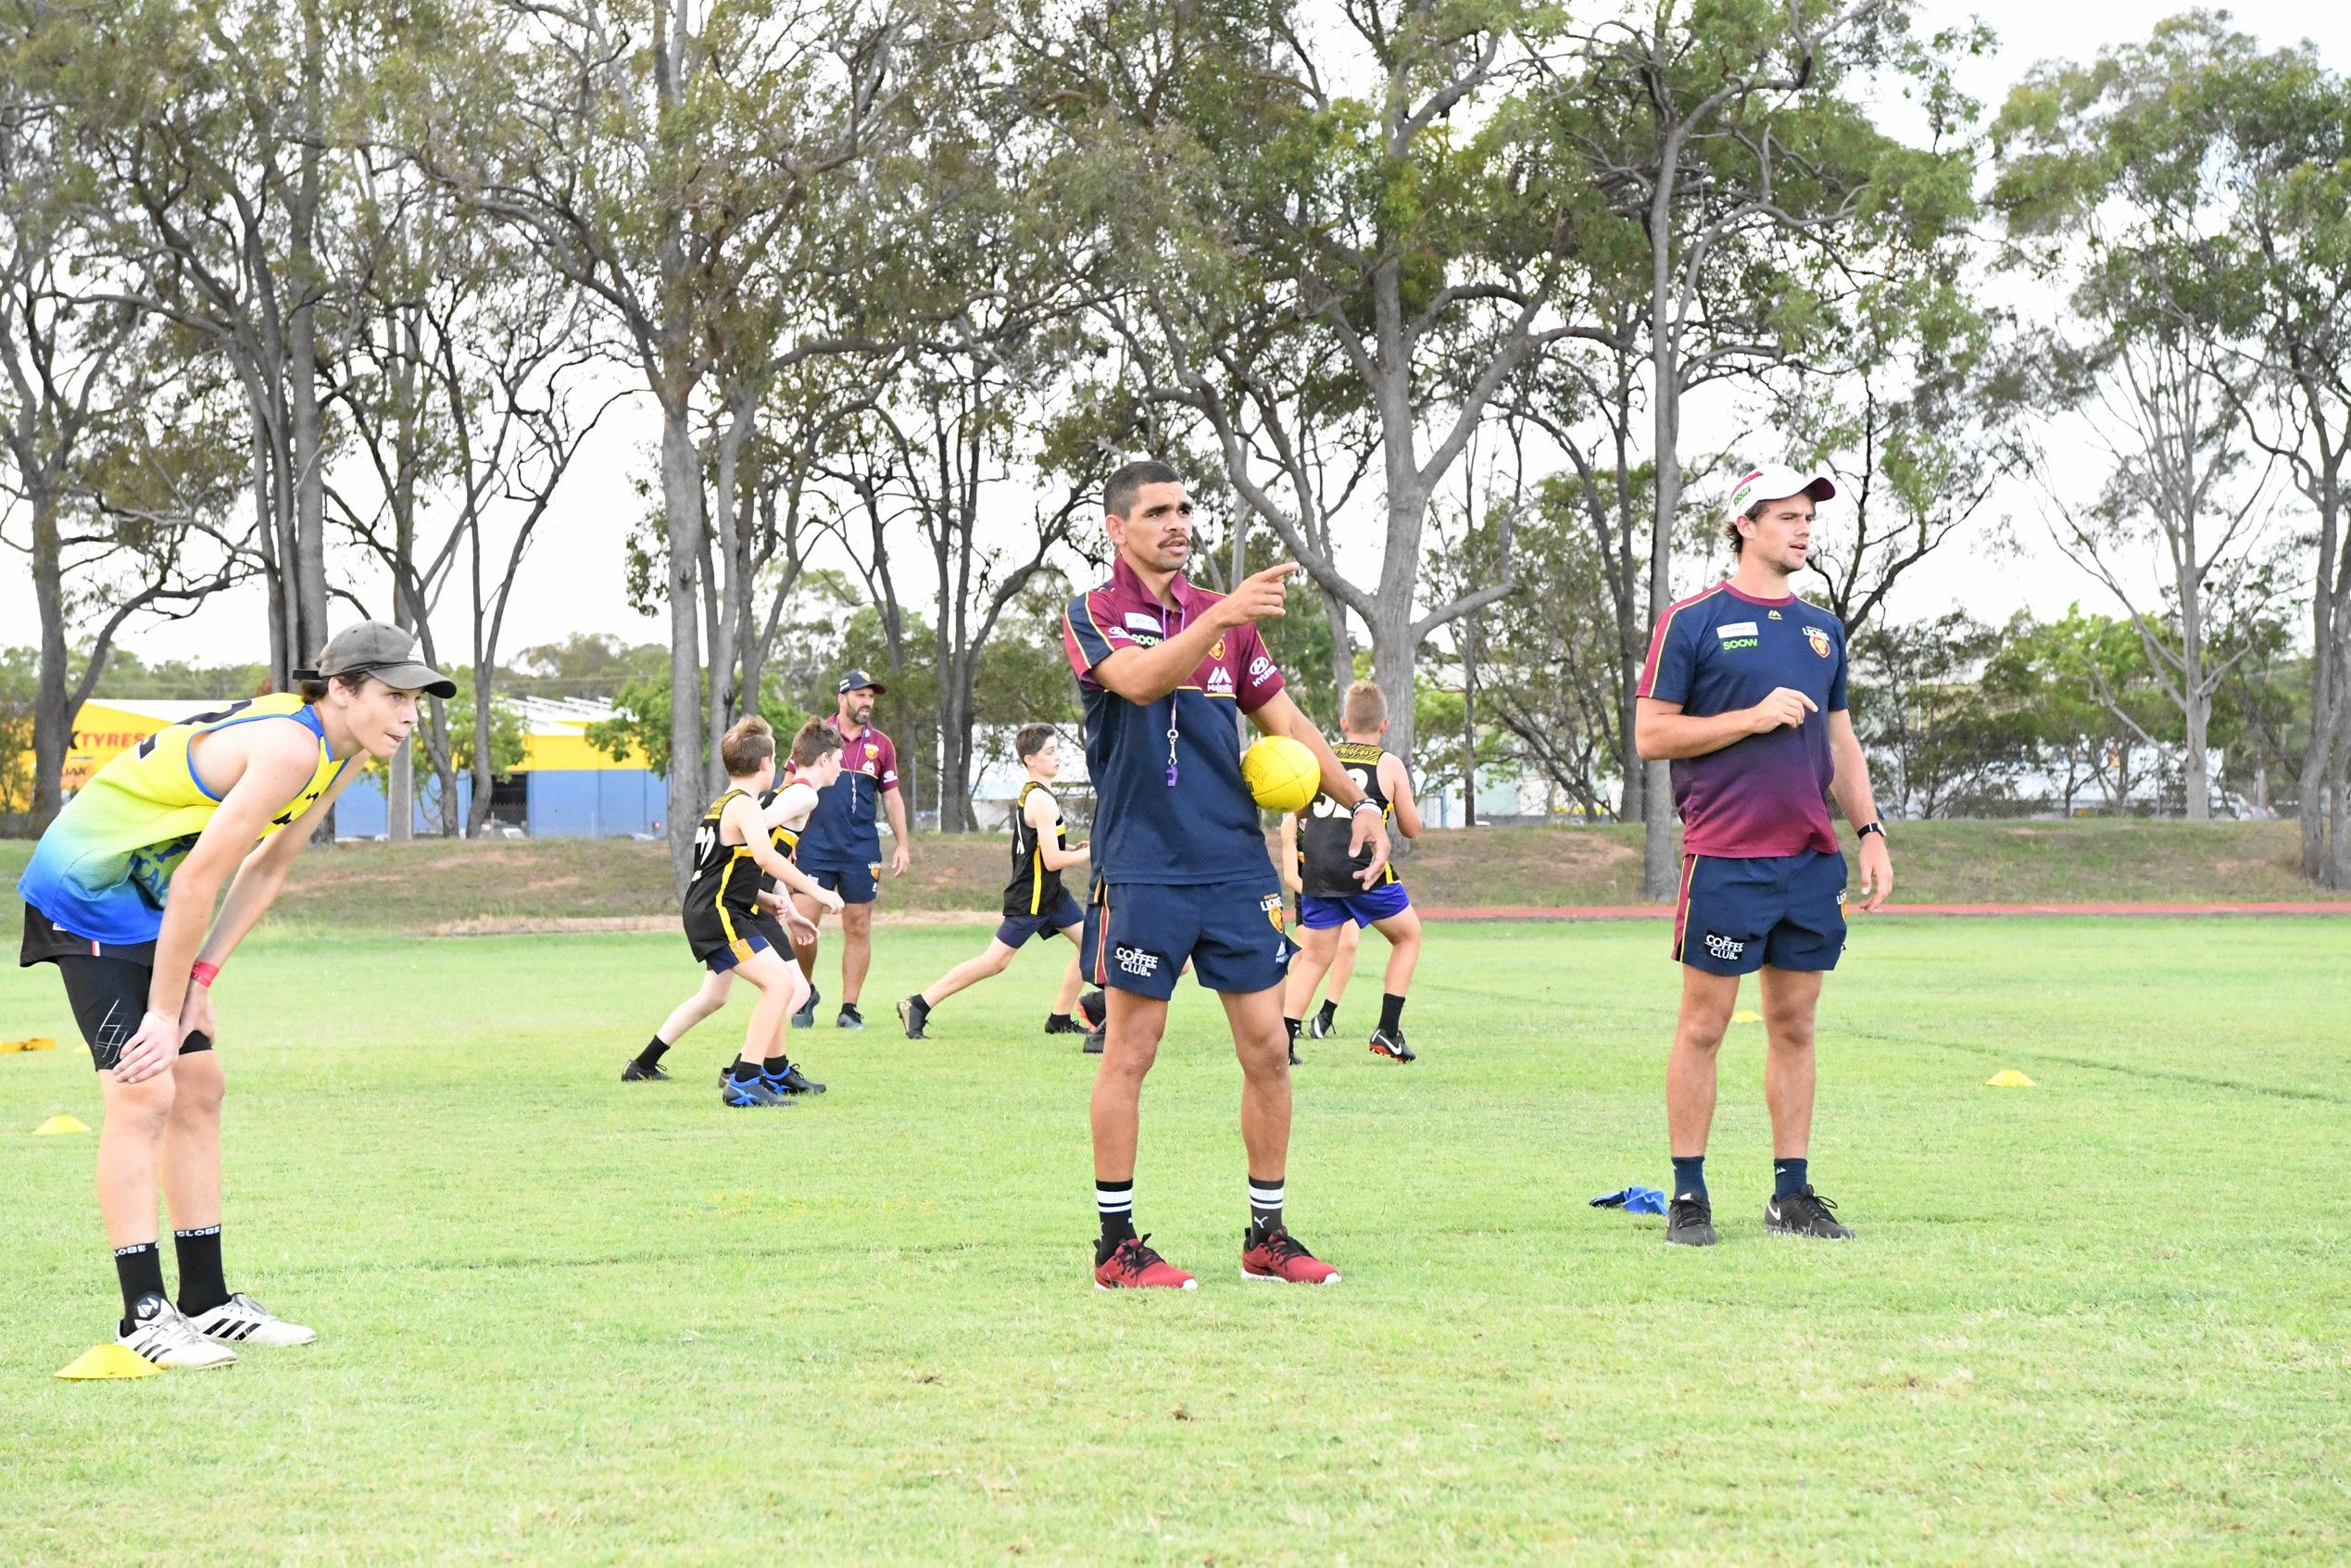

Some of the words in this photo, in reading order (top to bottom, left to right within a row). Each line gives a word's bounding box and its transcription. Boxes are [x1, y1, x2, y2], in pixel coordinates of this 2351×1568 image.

[81, 732, 145, 748] TYRES
[1704, 935, 1745, 953] COFFEE
[1114, 947, 1159, 970] COFFEE
